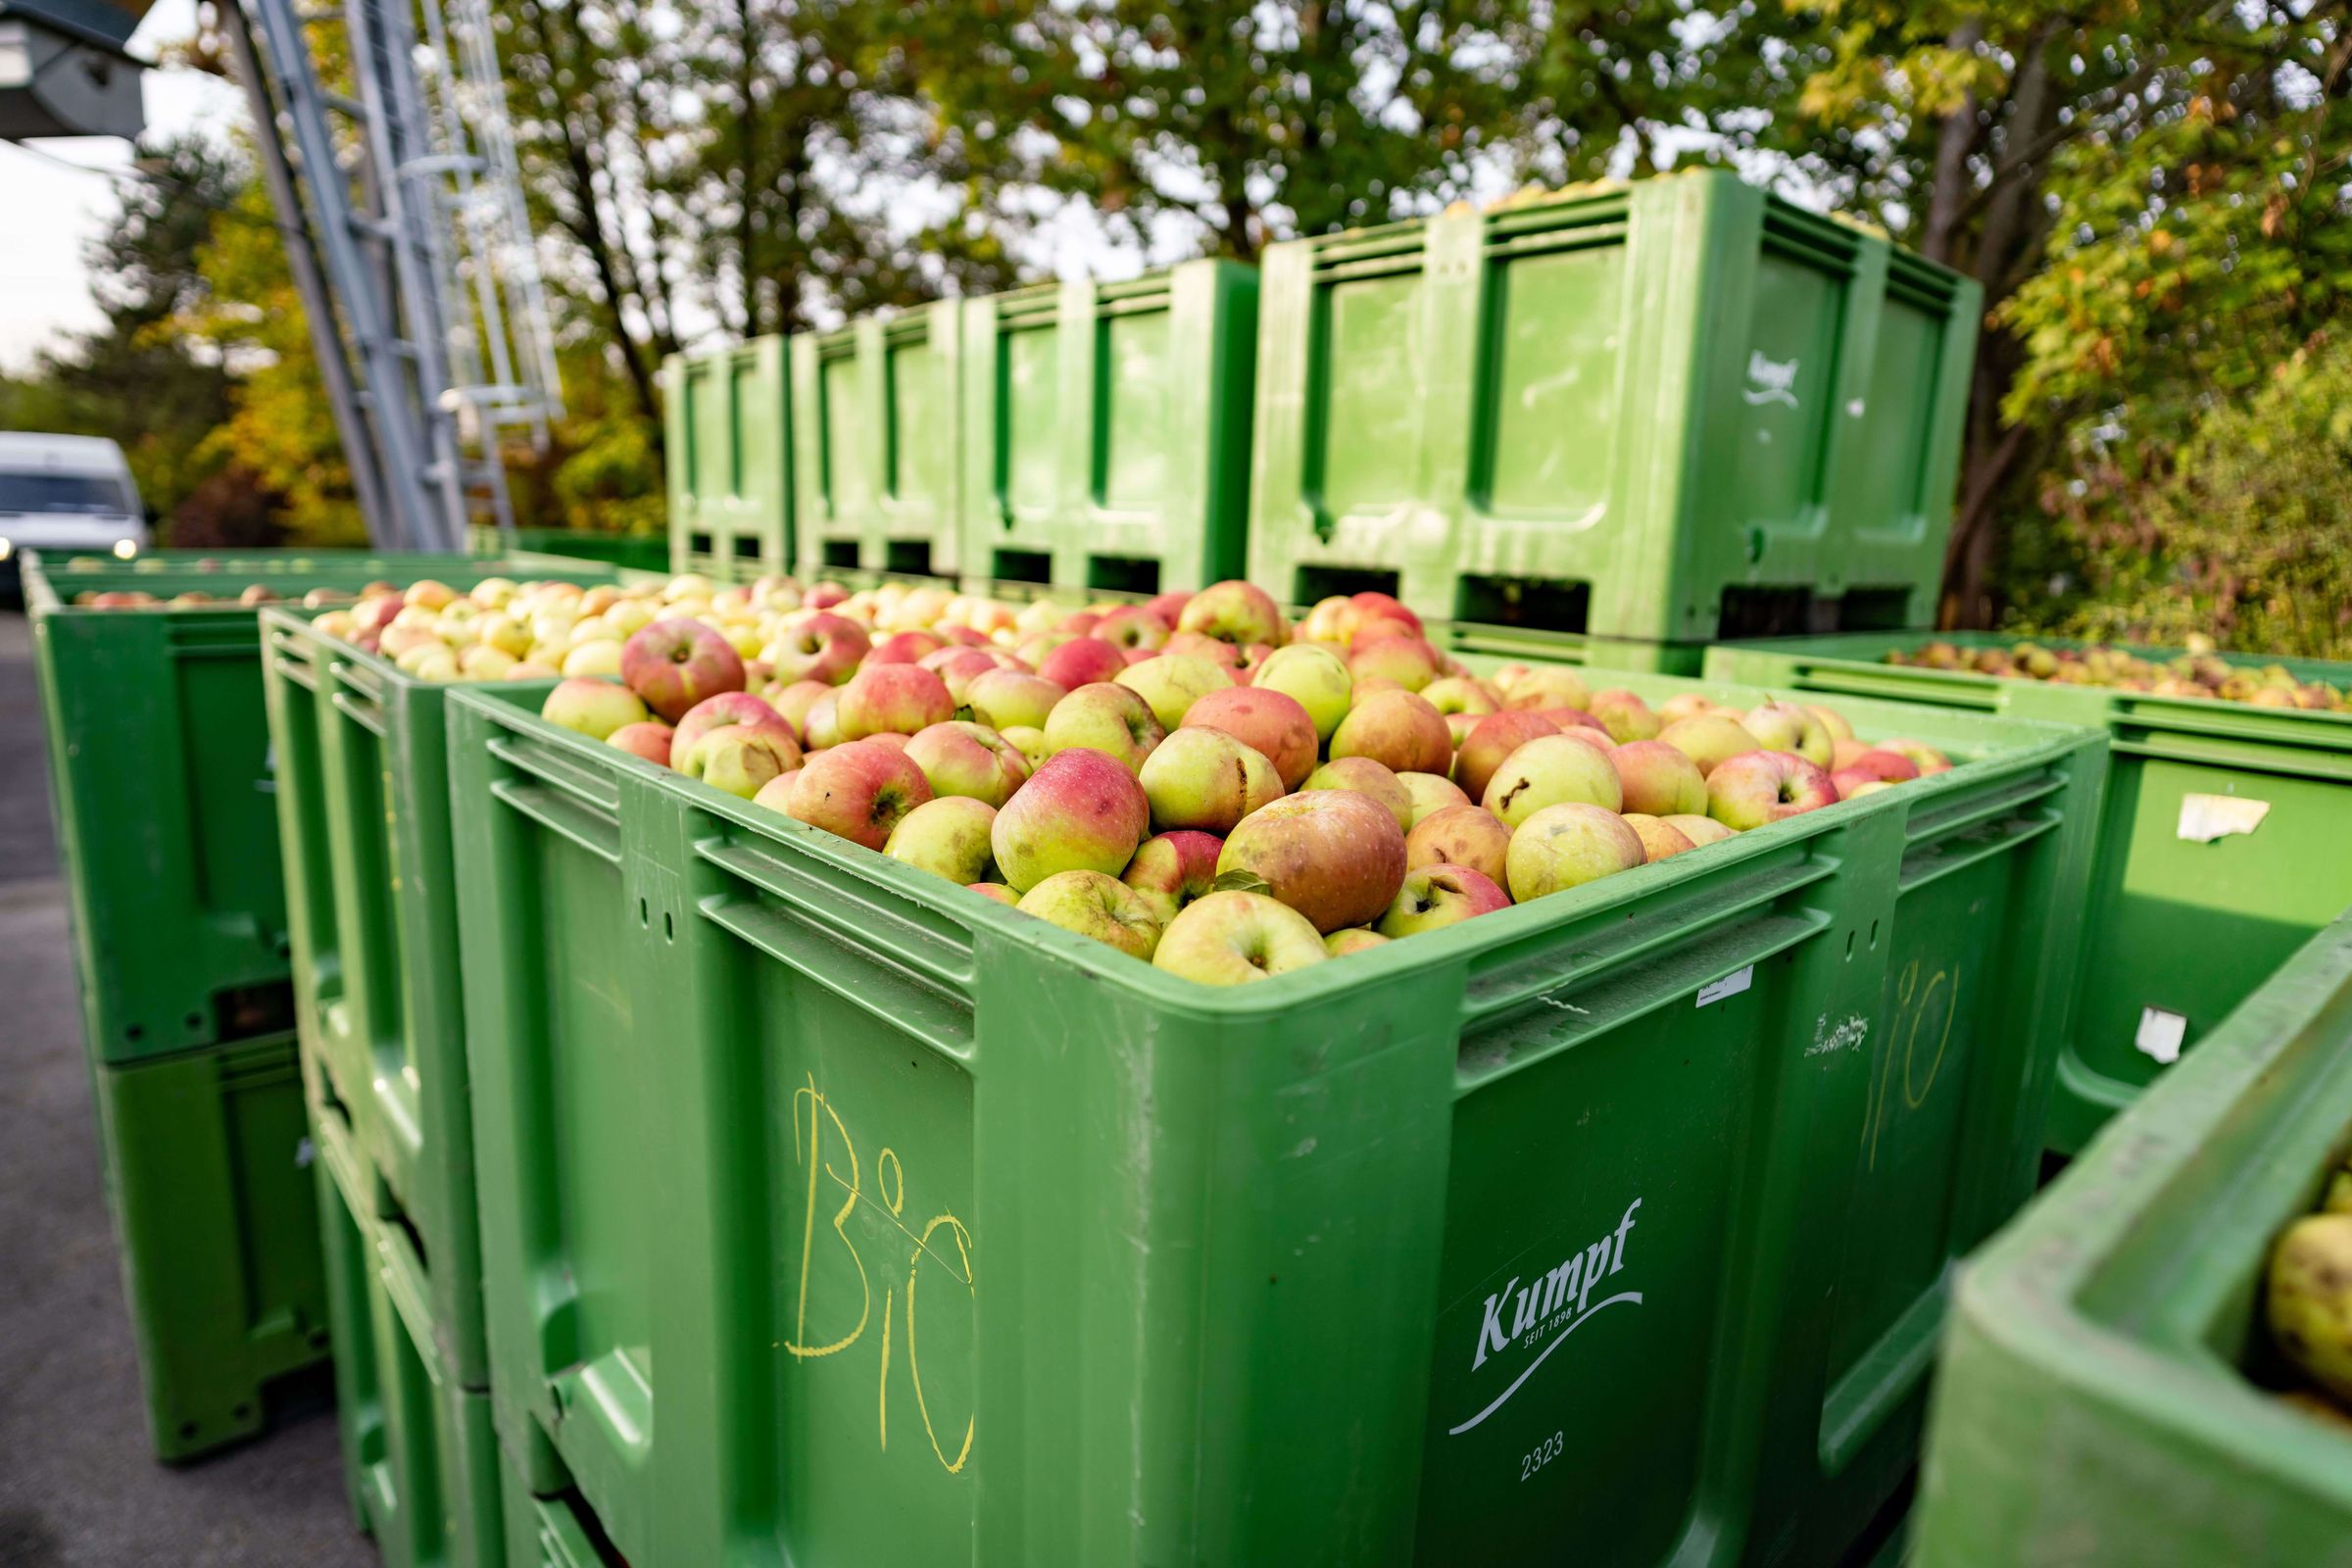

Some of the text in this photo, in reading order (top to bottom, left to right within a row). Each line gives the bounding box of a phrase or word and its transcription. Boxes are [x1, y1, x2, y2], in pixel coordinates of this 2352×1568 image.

[1472, 1197, 1642, 1372] Kumpf
[1523, 1306, 1573, 1349] SEIT 1898
[1521, 1431, 1563, 1482] 2323
